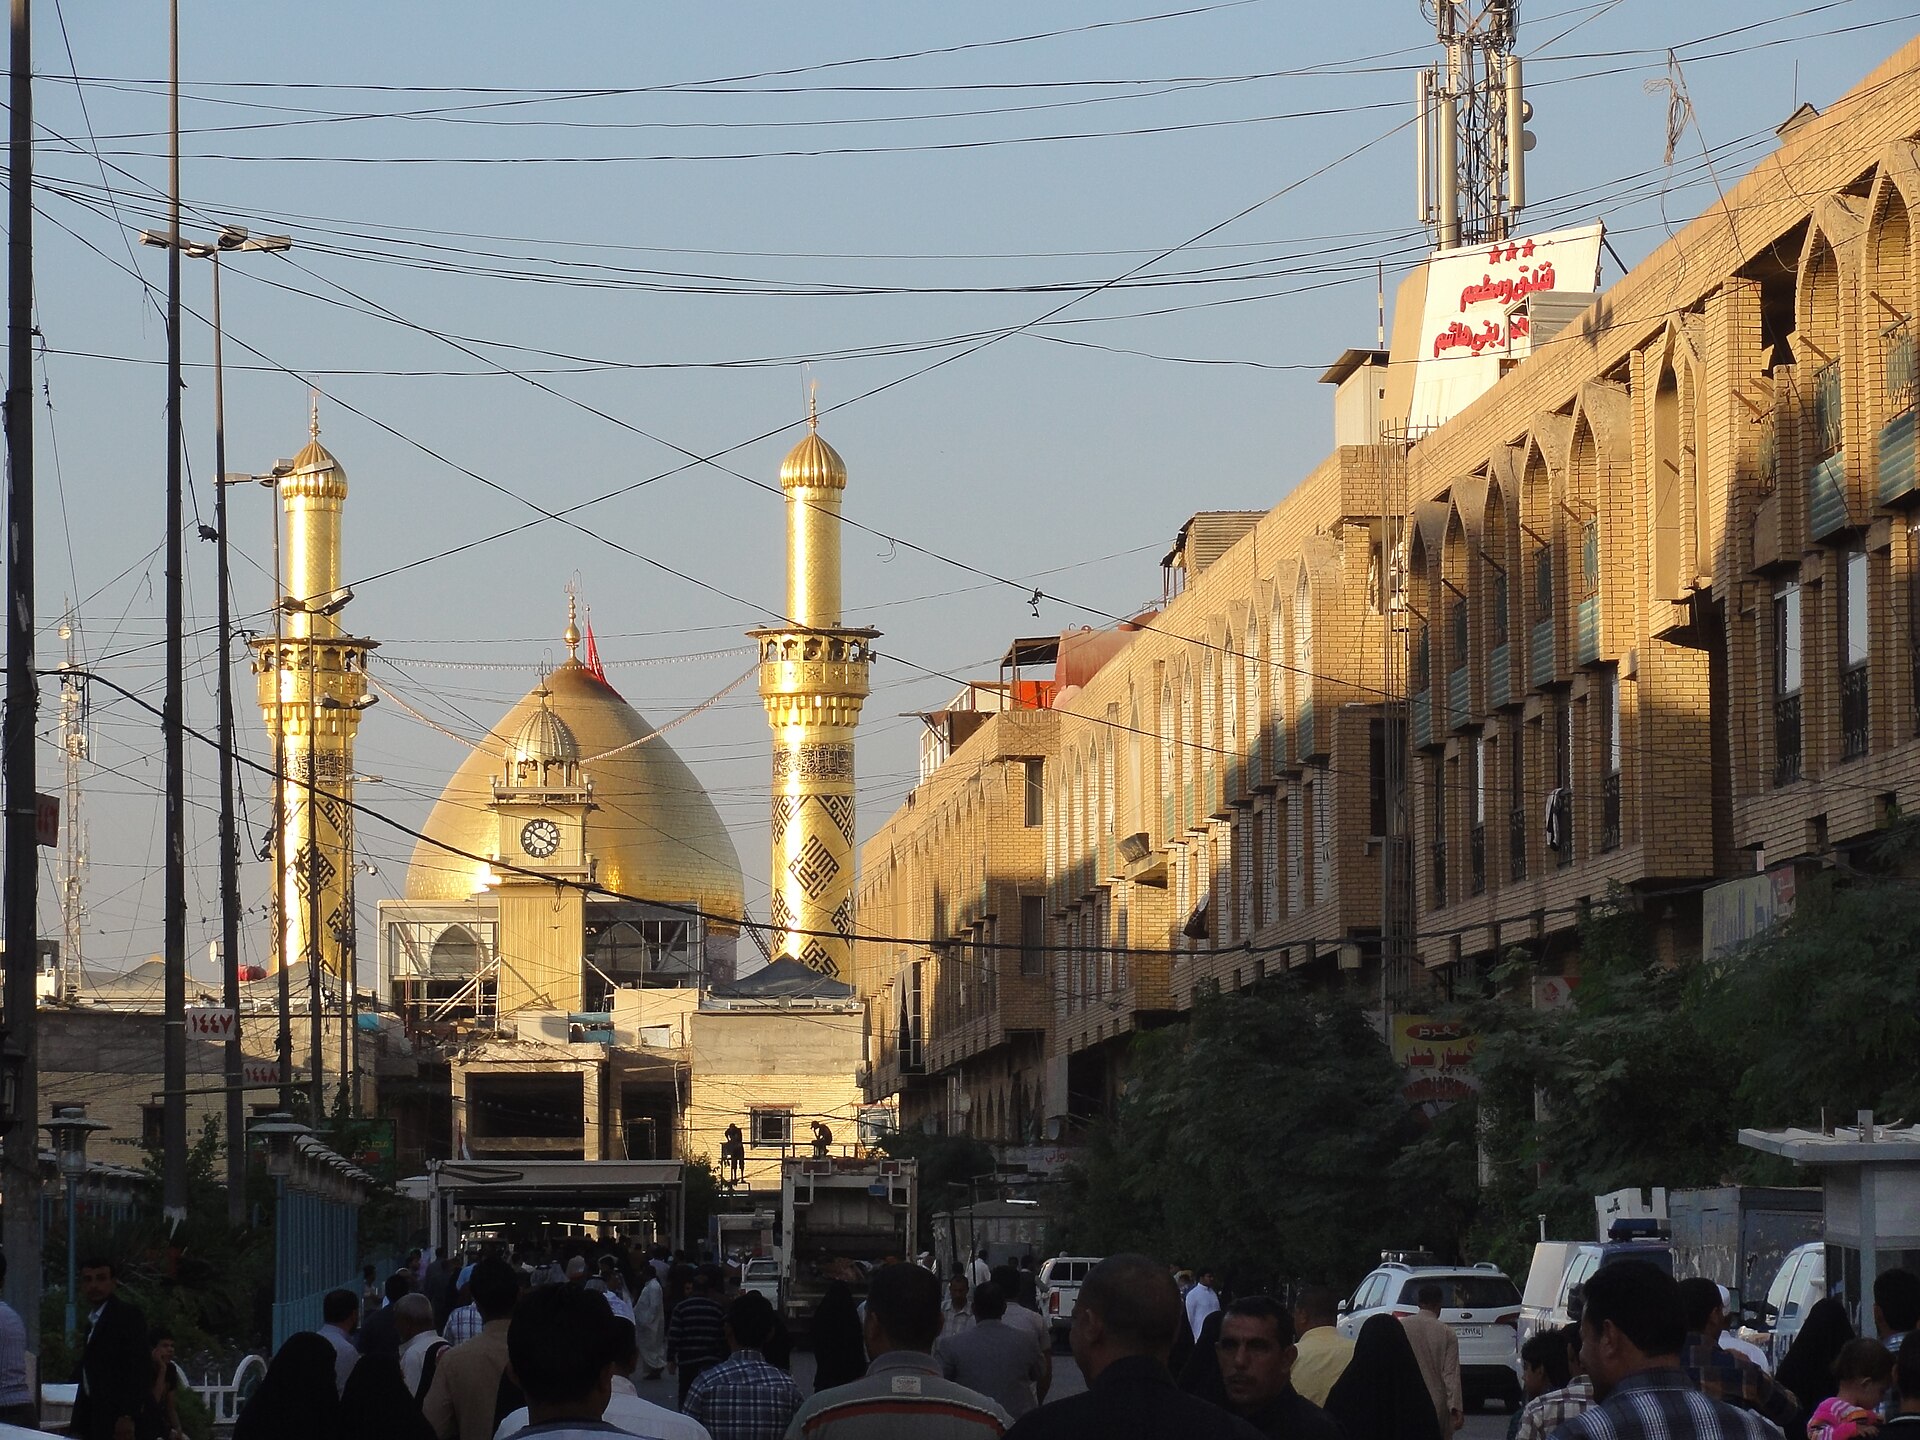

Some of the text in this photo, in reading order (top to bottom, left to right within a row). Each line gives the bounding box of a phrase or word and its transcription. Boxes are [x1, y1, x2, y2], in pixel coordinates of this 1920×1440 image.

[1460, 274, 1513, 313] ومطعم
[1433, 321, 1475, 358] هاشم
[192, 1013, 233, 1034] ١٤٤٧
[244, 1067, 279, 1081] ١٤٤٨
